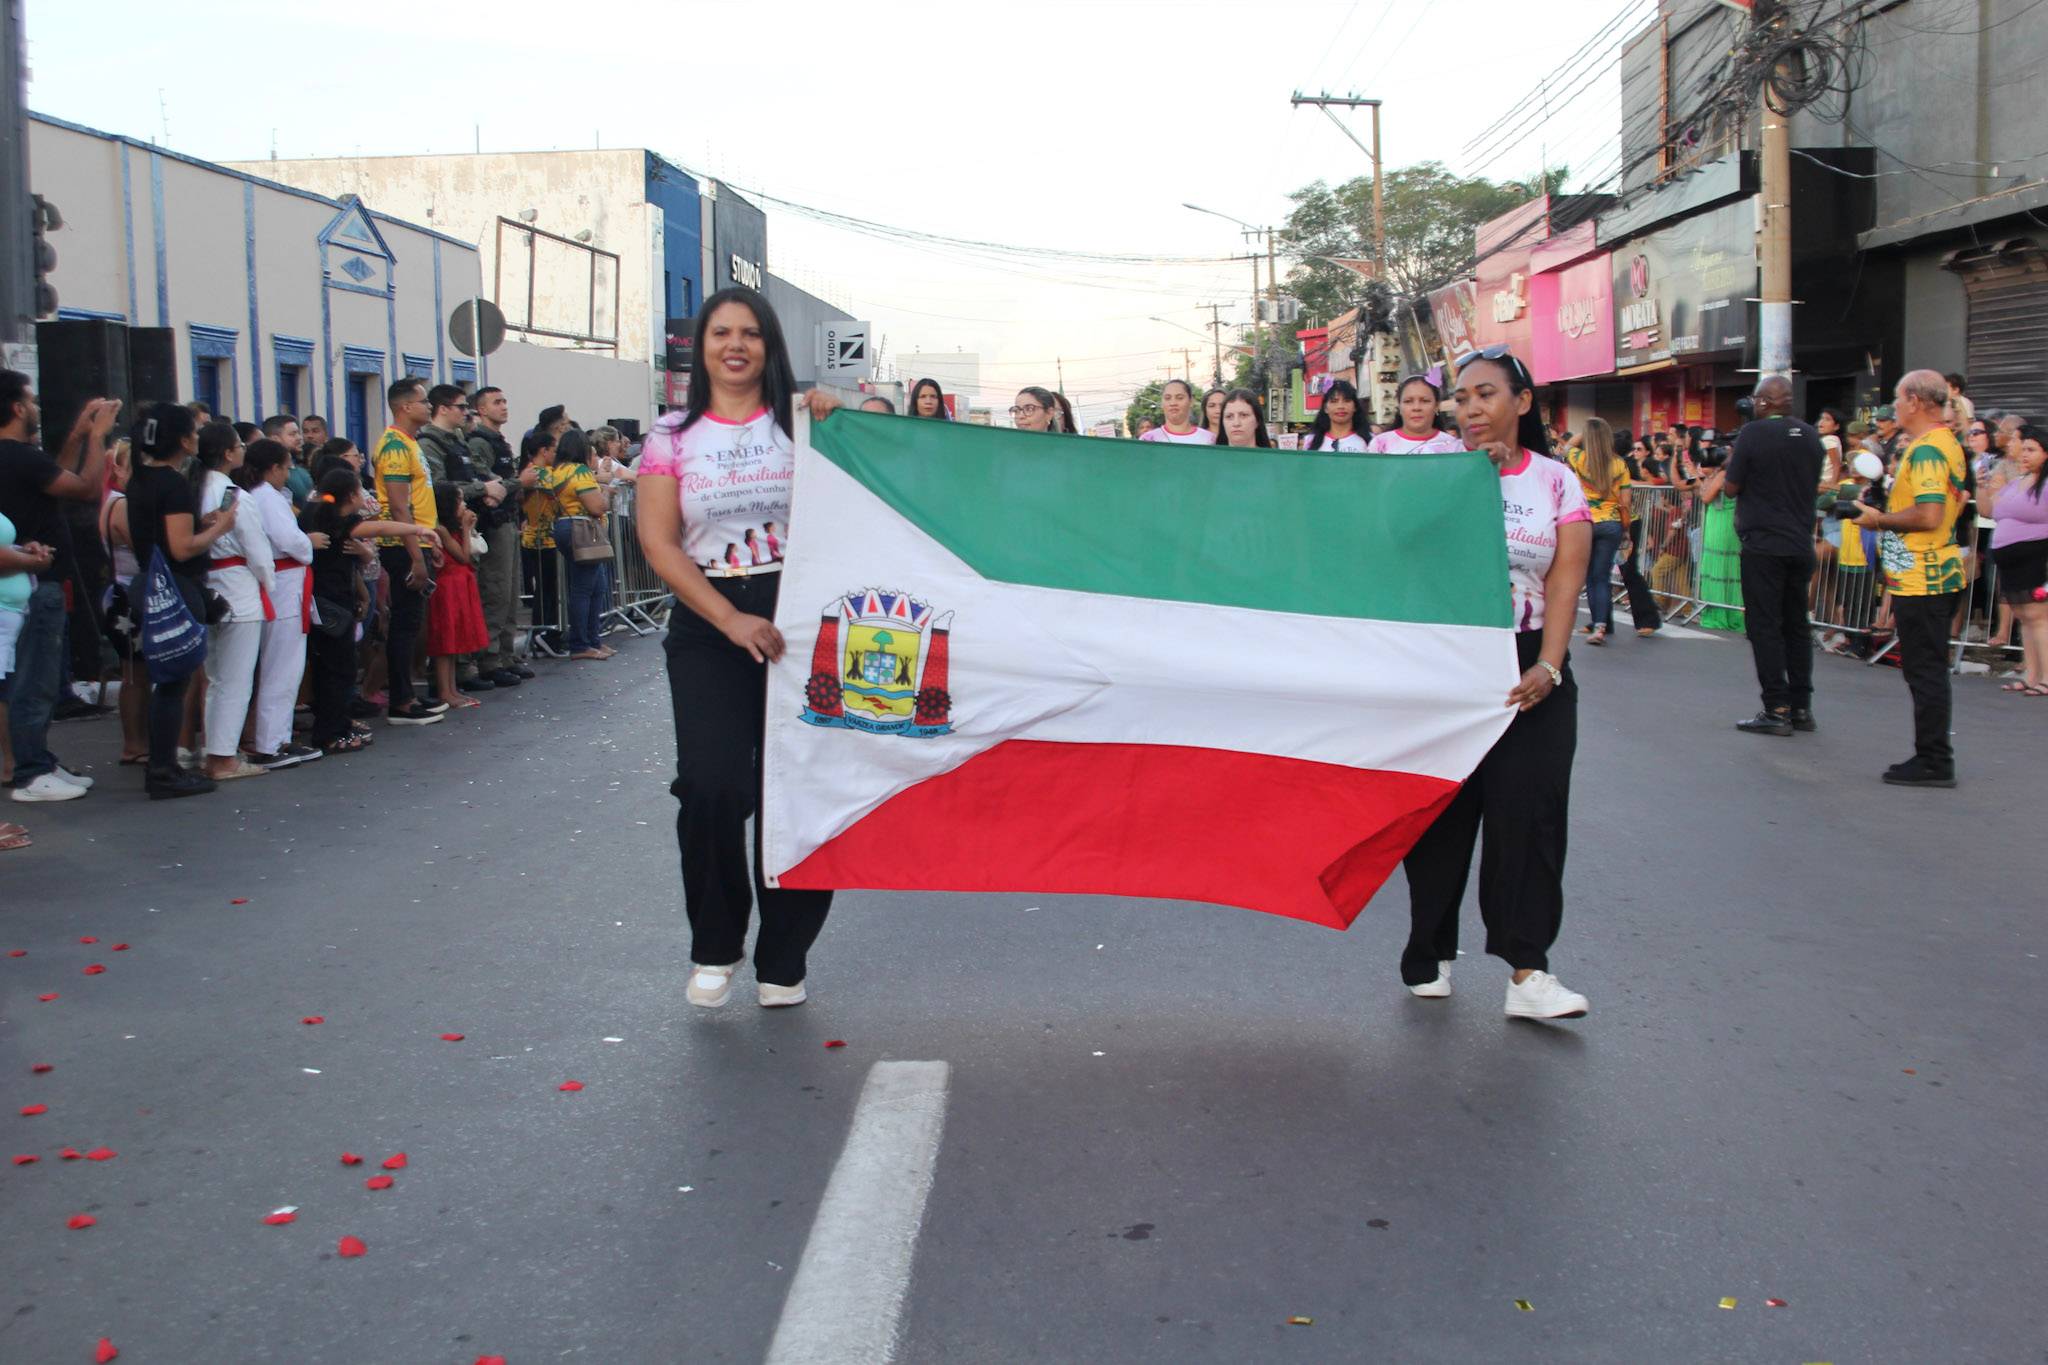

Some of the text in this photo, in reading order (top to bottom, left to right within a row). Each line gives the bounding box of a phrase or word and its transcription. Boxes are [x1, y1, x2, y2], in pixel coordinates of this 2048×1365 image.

[827, 330, 836, 370] STUDIO
[716, 444, 764, 461] EMEB
[682, 465, 794, 494] Rita Auxiliado
[700, 485, 786, 502] de Campos Cunha
[750, 500, 788, 514] Mulher
[1506, 545, 1537, 559] Cunha
